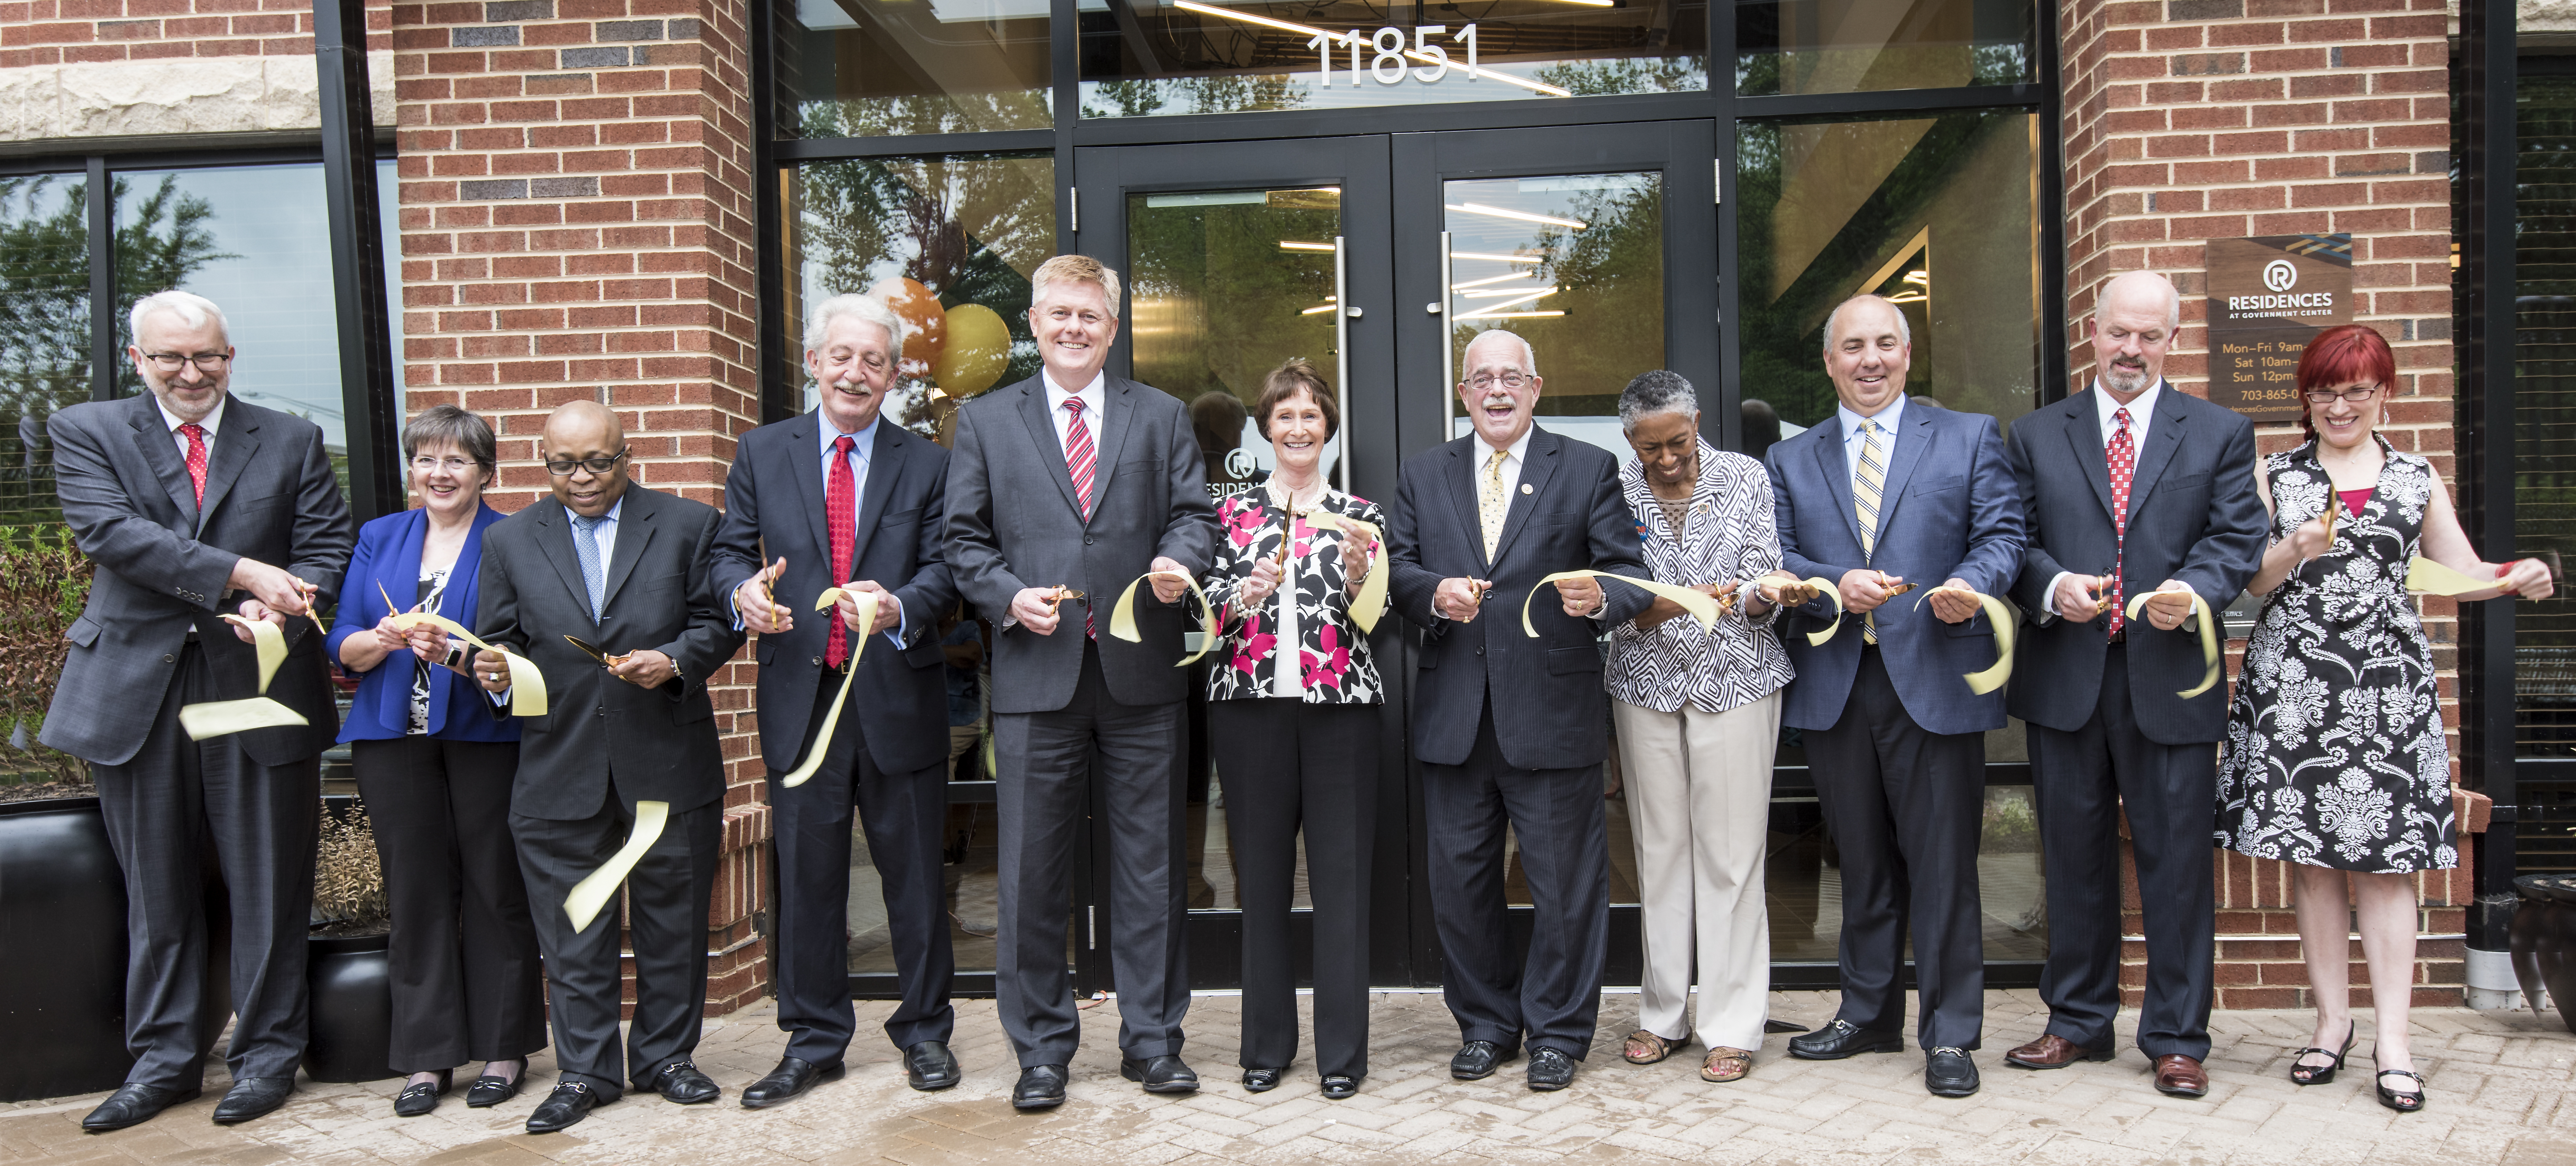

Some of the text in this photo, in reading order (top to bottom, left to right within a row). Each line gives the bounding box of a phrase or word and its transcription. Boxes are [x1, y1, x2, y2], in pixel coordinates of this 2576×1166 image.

[1307, 24, 1477, 86] 11851
[2229, 293, 2332, 310] RESIDENCES
[2279, 342, 2308, 352] 9am–
[2235, 356, 2299, 367] Sat 10am–
[2233, 371, 2298, 383] Sun 12pm–
[2241, 389, 2299, 400] 703-865-0
